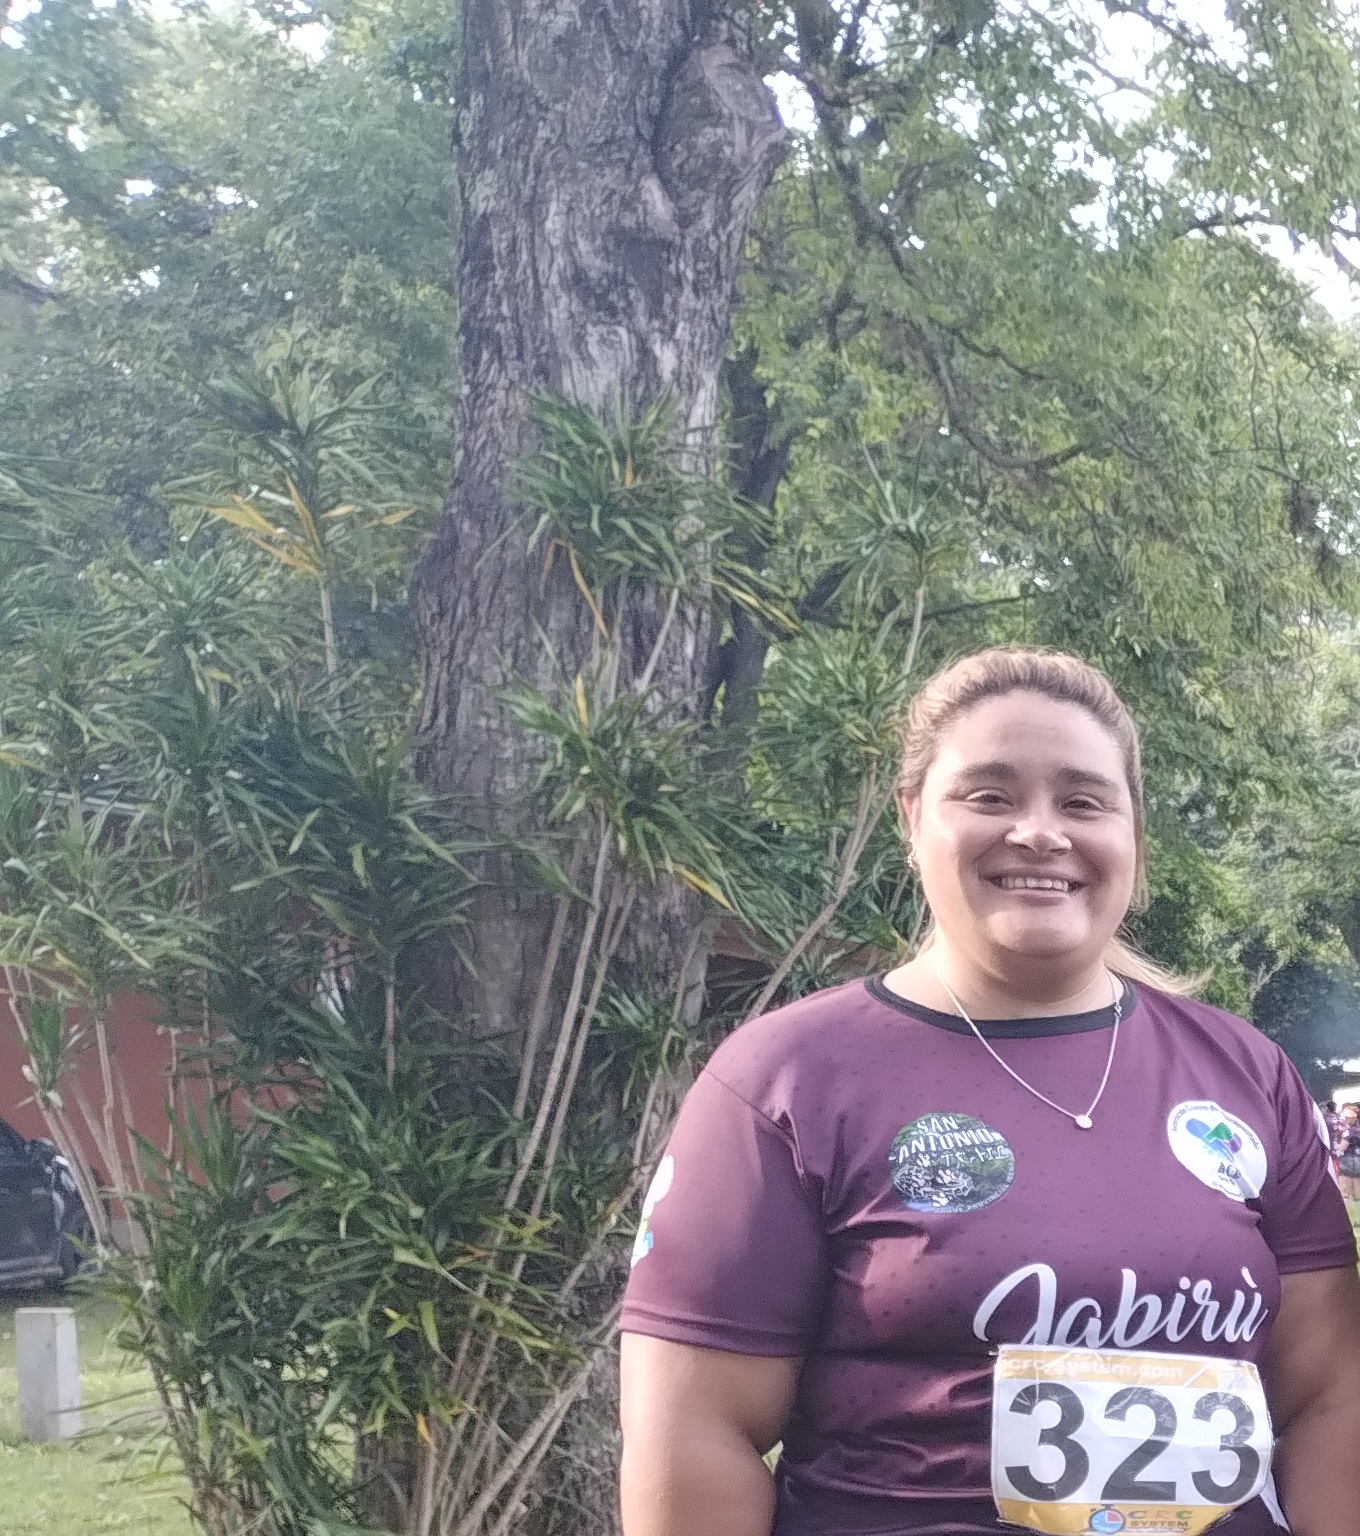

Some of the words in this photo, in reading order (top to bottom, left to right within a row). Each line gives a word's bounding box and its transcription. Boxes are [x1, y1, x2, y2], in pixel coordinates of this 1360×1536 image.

[916, 1115, 959, 1134] SAN
[898, 1128, 995, 1164] ANTONIO
[1004, 1382, 1261, 1502] 323
[1129, 1520, 1189, 1528] SYSTEM
